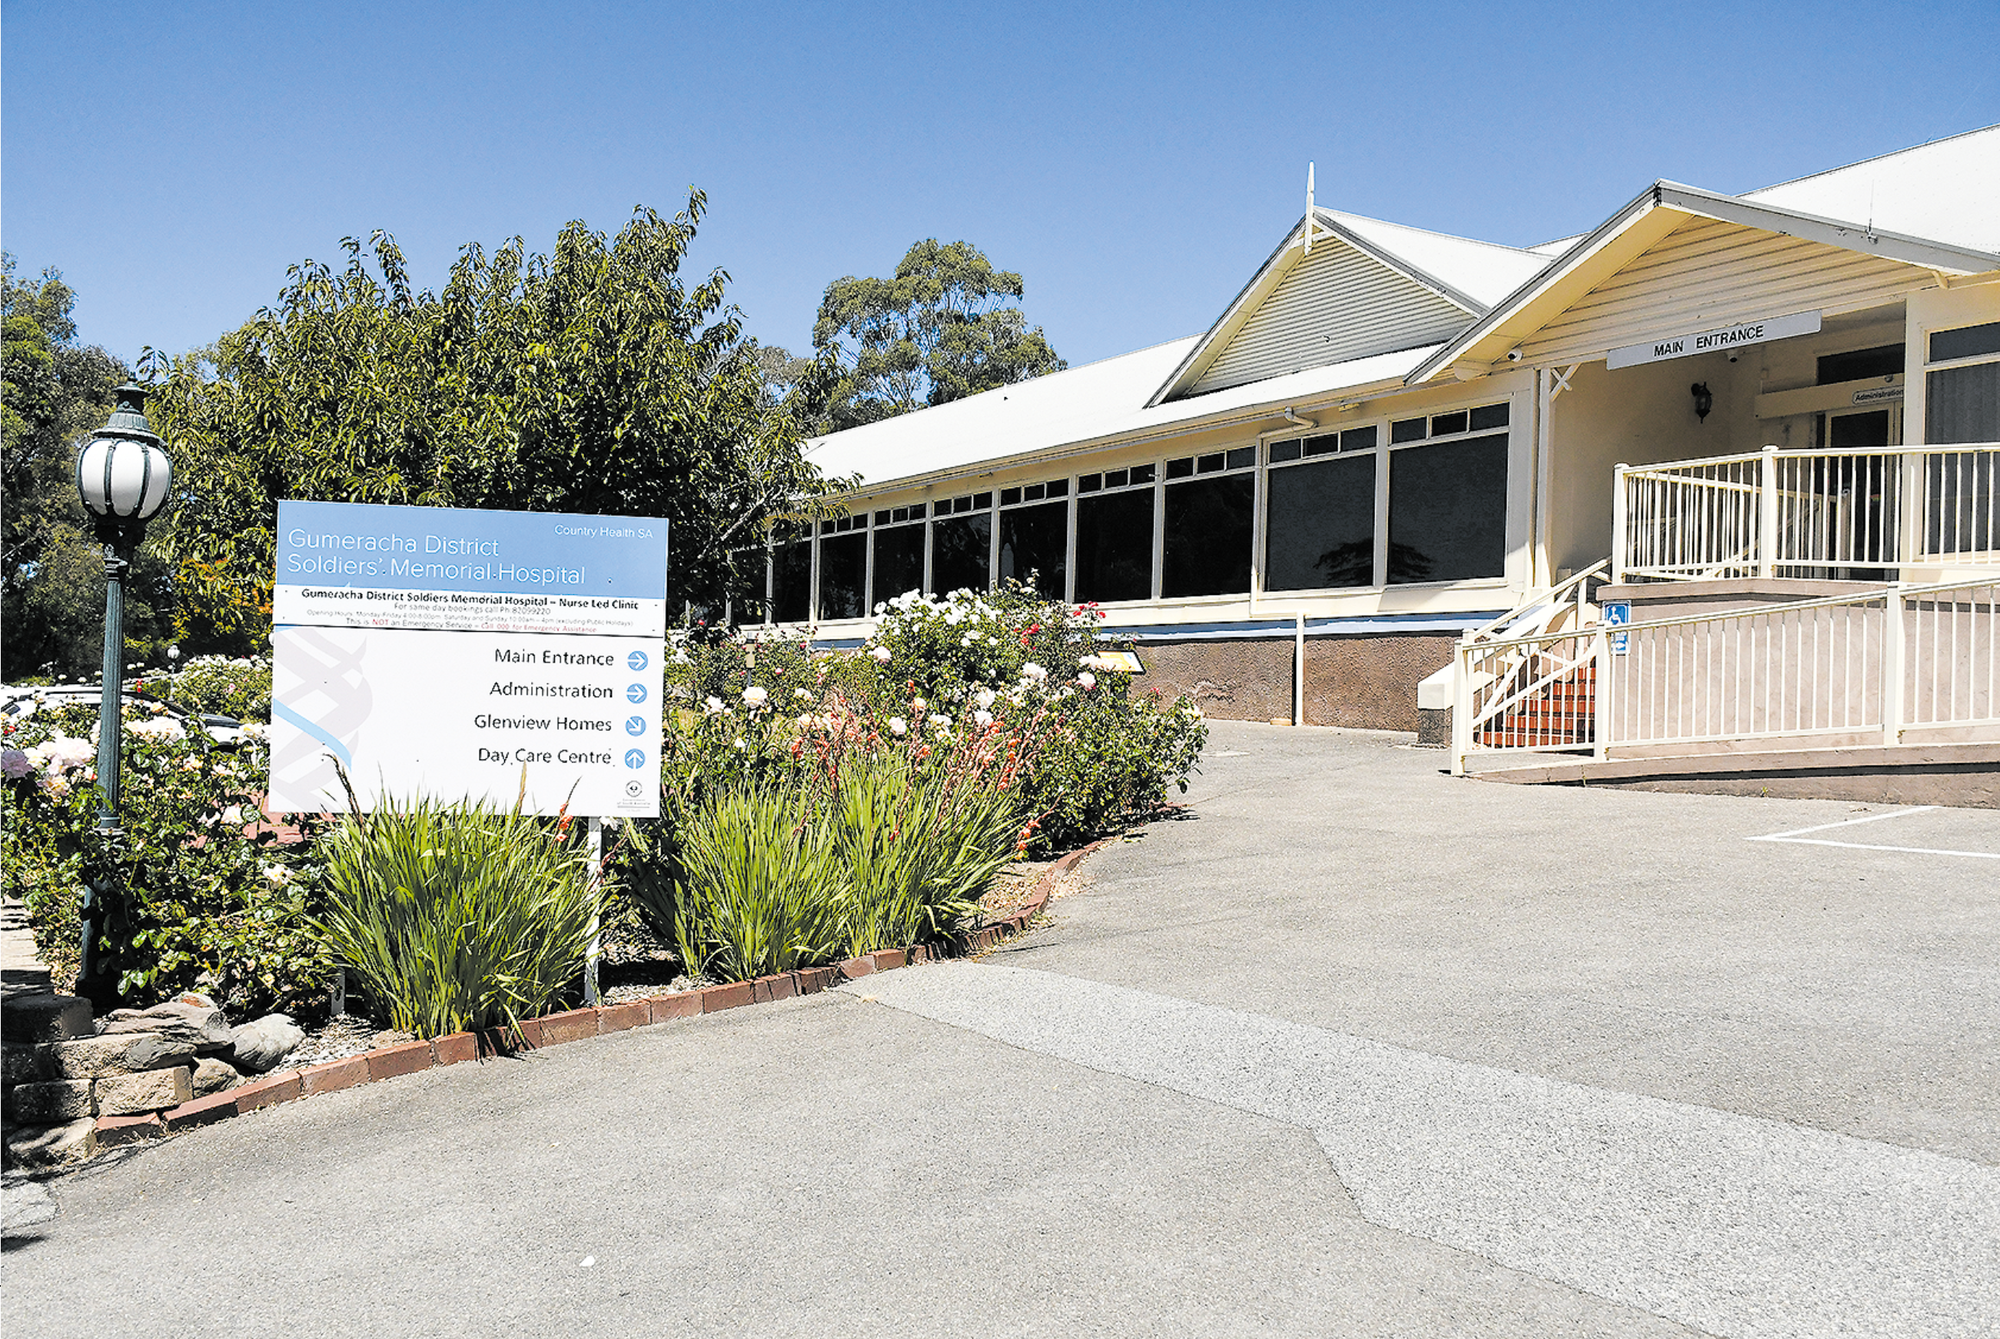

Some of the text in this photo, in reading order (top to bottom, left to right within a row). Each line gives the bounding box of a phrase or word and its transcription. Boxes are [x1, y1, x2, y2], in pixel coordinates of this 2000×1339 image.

[1653, 325, 1764, 356] MAIN ENTRANCE
[554, 524, 653, 539] Country Health SA
[288, 528, 499, 556] Gumeracha District
[391, 558, 491, 580] Memorial
[499, 563, 586, 586] Hospital
[301, 588, 363, 600] Gumeracha
[366, 591, 404, 601] District
[407, 592, 449, 603] Soldiers
[451, 594, 502, 604] Memorial
[505, 596, 548, 607] Hospital
[559, 598, 589, 608] Nurse
[591, 600, 609, 609] Led
[612, 600, 639, 610] Clinic
[394, 602, 407, 610] For
[432, 604, 445, 612] day
[448, 605, 483, 614] bookings
[346, 617, 361, 625] This
[402, 619, 443, 628] Emergency
[445, 621, 472, 629] Service
[523, 624, 560, 632] Emergency
[494, 649, 614, 666] Main Entrance
[489, 681, 613, 698] Administration
[474, 714, 612, 731] Glenview Homes
[478, 748, 612, 765] Day Care Centre
